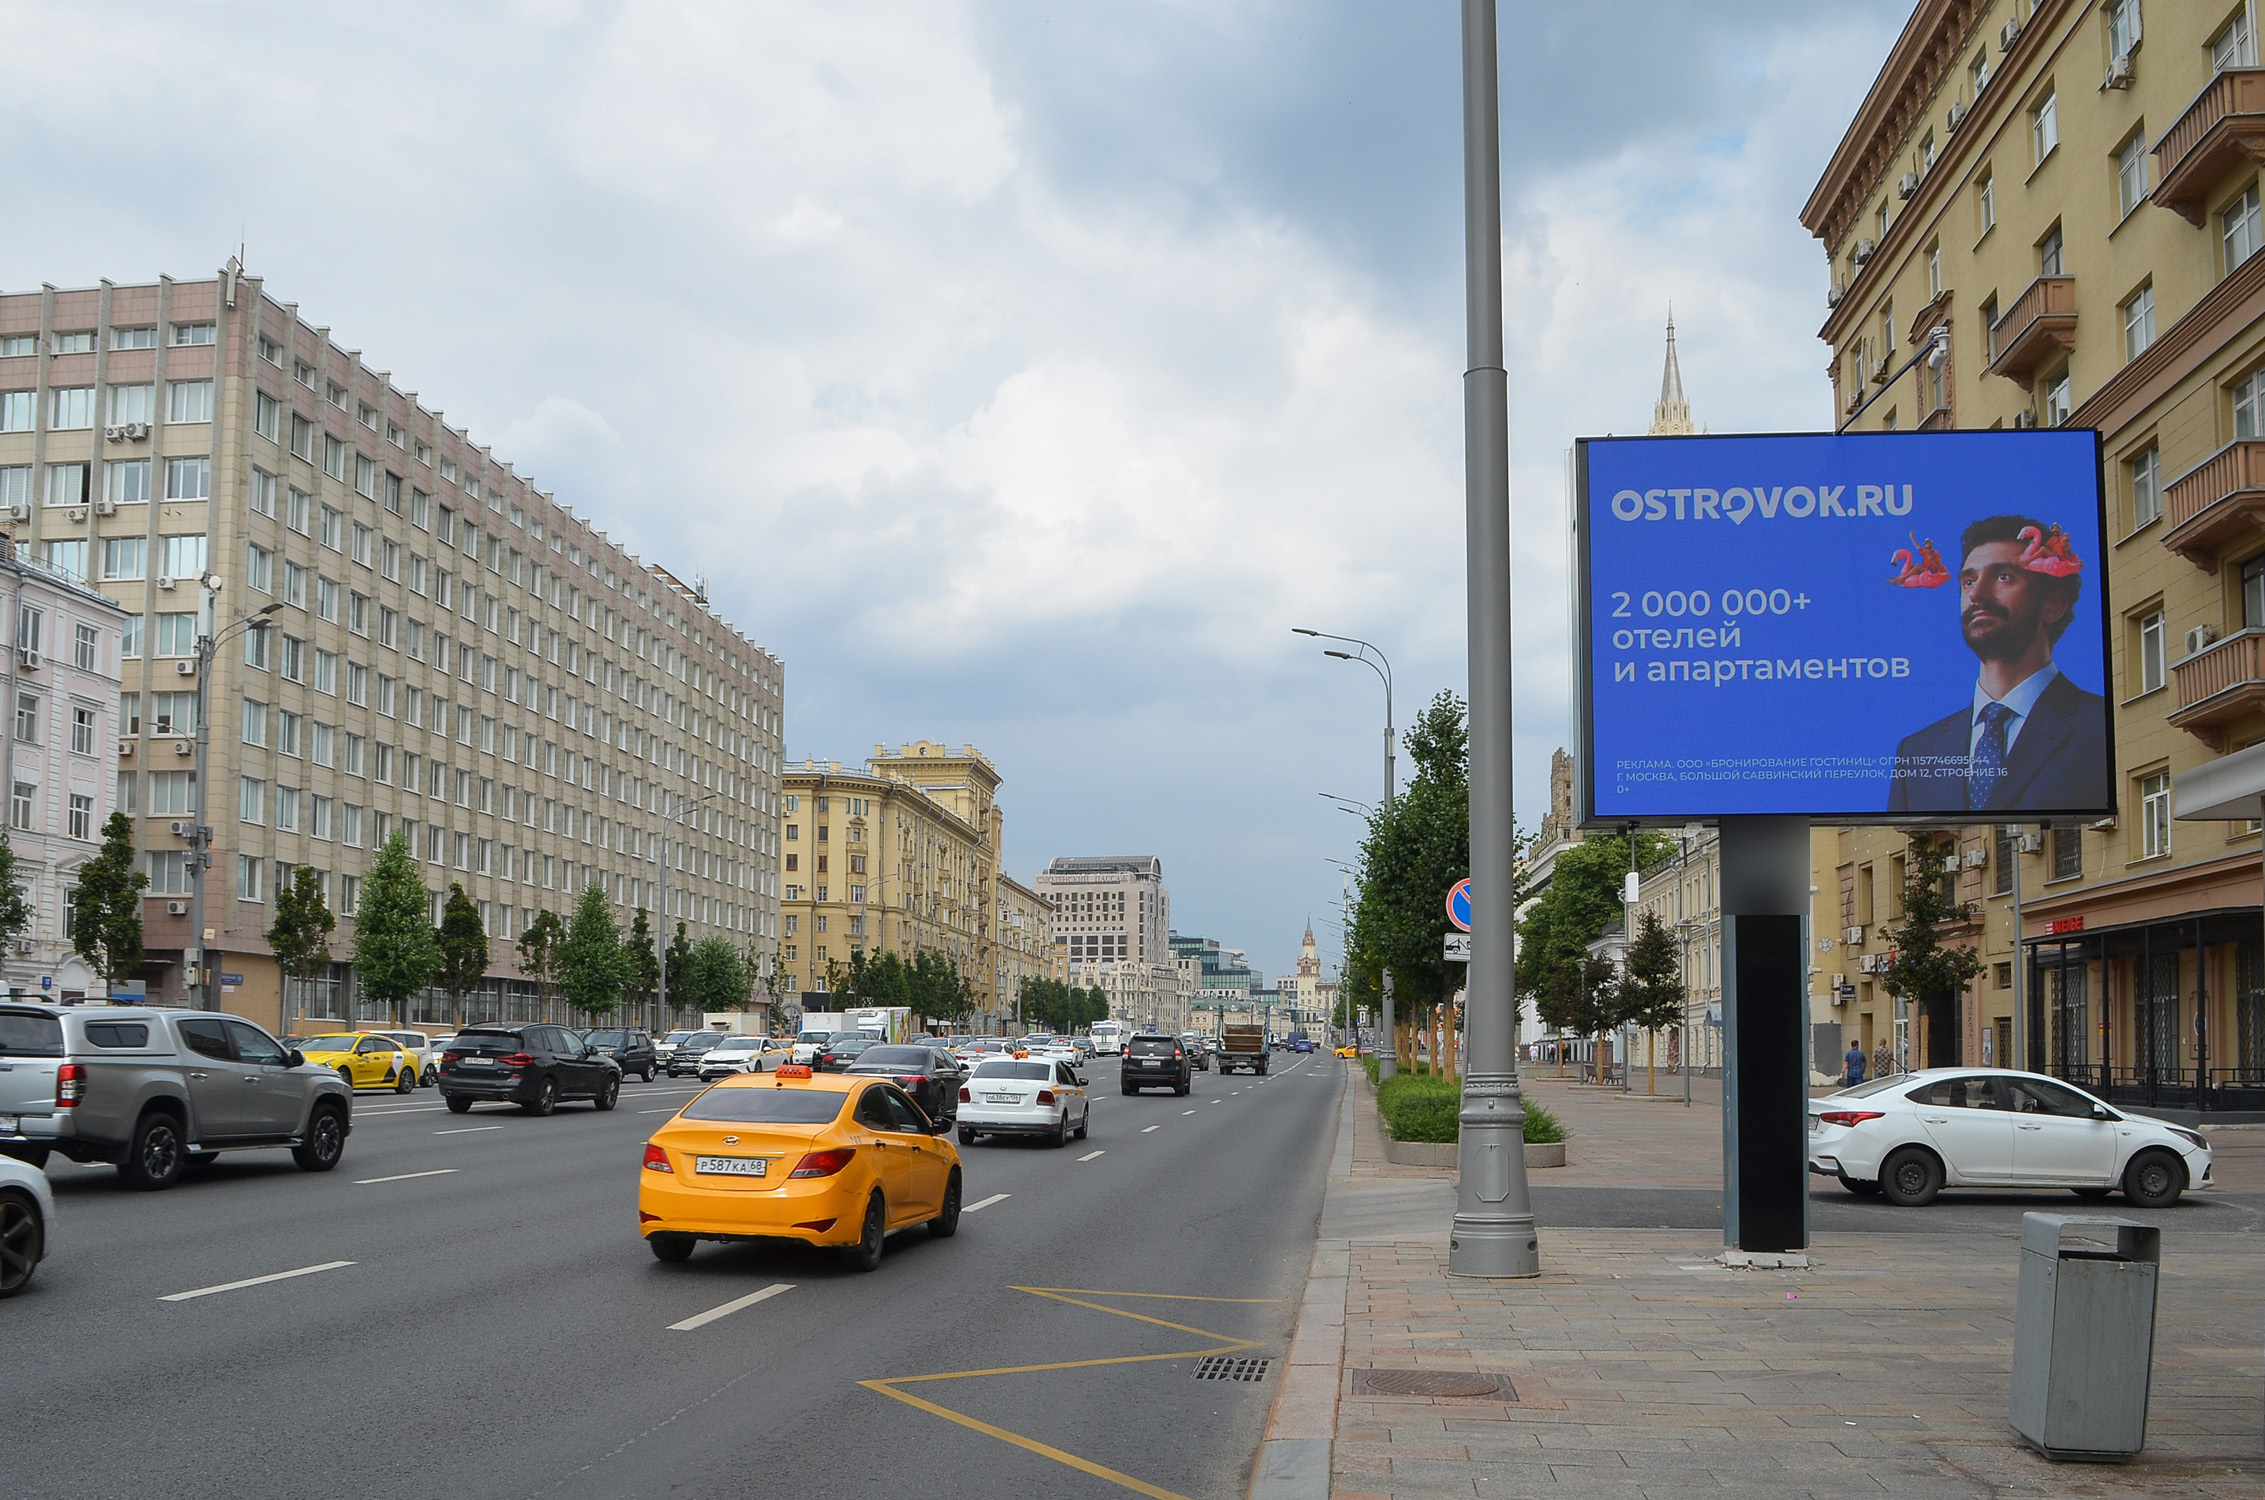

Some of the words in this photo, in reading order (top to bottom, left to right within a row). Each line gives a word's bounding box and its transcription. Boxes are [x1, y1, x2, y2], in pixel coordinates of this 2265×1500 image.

[1611, 484, 1913, 526] OSTROVOK.RU
[1611, 592, 1632, 618] 2
[1641, 590, 1711, 617] 000
[1721, 588, 1811, 616] 000+
[1612, 620, 1741, 650] отелей
[1614, 661, 1635, 682] и
[1647, 657, 1910, 687] апартаментов
[1616, 760, 1675, 770] РЕКЛАМА.
[1676, 759, 1704, 769] ООО
[1705, 758, 1807, 769] «БРОНИРОВАНИЕ
[1810, 757, 1877, 768] ГОСТИНИЦ»
[1879, 756, 1910, 766] ОГРН
[1626, 772, 1678, 783] МОСКВА,
[1680, 769, 1740, 781] БОЛЬШОЙ
[1742, 769, 1822, 780] САВВИНСКИЙ
[1824, 768, 1888, 779] ПЕРЕУЛОК,
[1889, 768, 1917, 779] ДОМ
[1919, 768, 1932, 779] 12,
[1934, 767, 1995, 778] СТРОЕНИЕ
[1997, 767, 2008, 777] 16
[1616, 785, 1630, 794] 0+
[750, 1161, 762, 1170] 68
